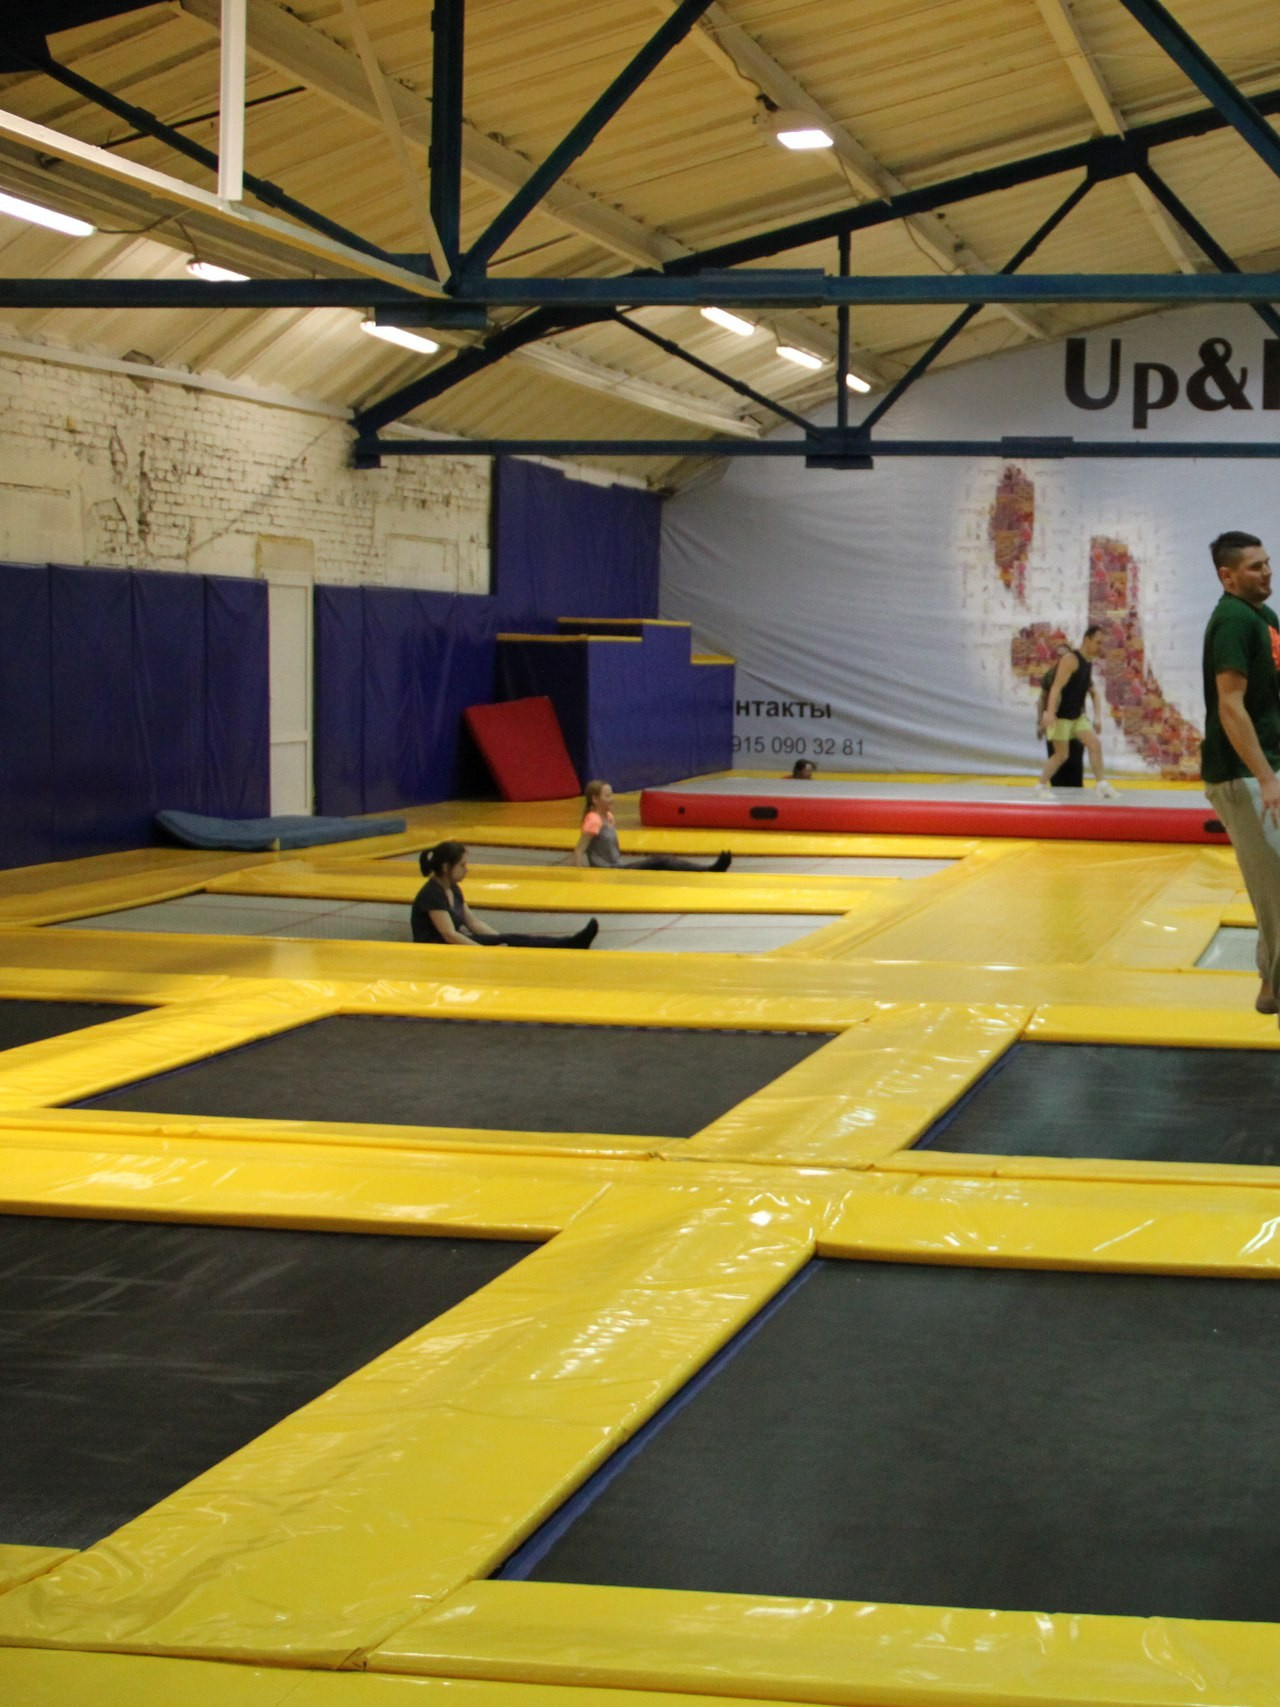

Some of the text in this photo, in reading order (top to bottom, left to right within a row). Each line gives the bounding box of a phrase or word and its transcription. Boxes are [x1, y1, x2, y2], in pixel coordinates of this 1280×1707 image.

[771, 736, 806, 755] 090
[813, 737, 836, 756] 32
[842, 738, 864, 756] 81
